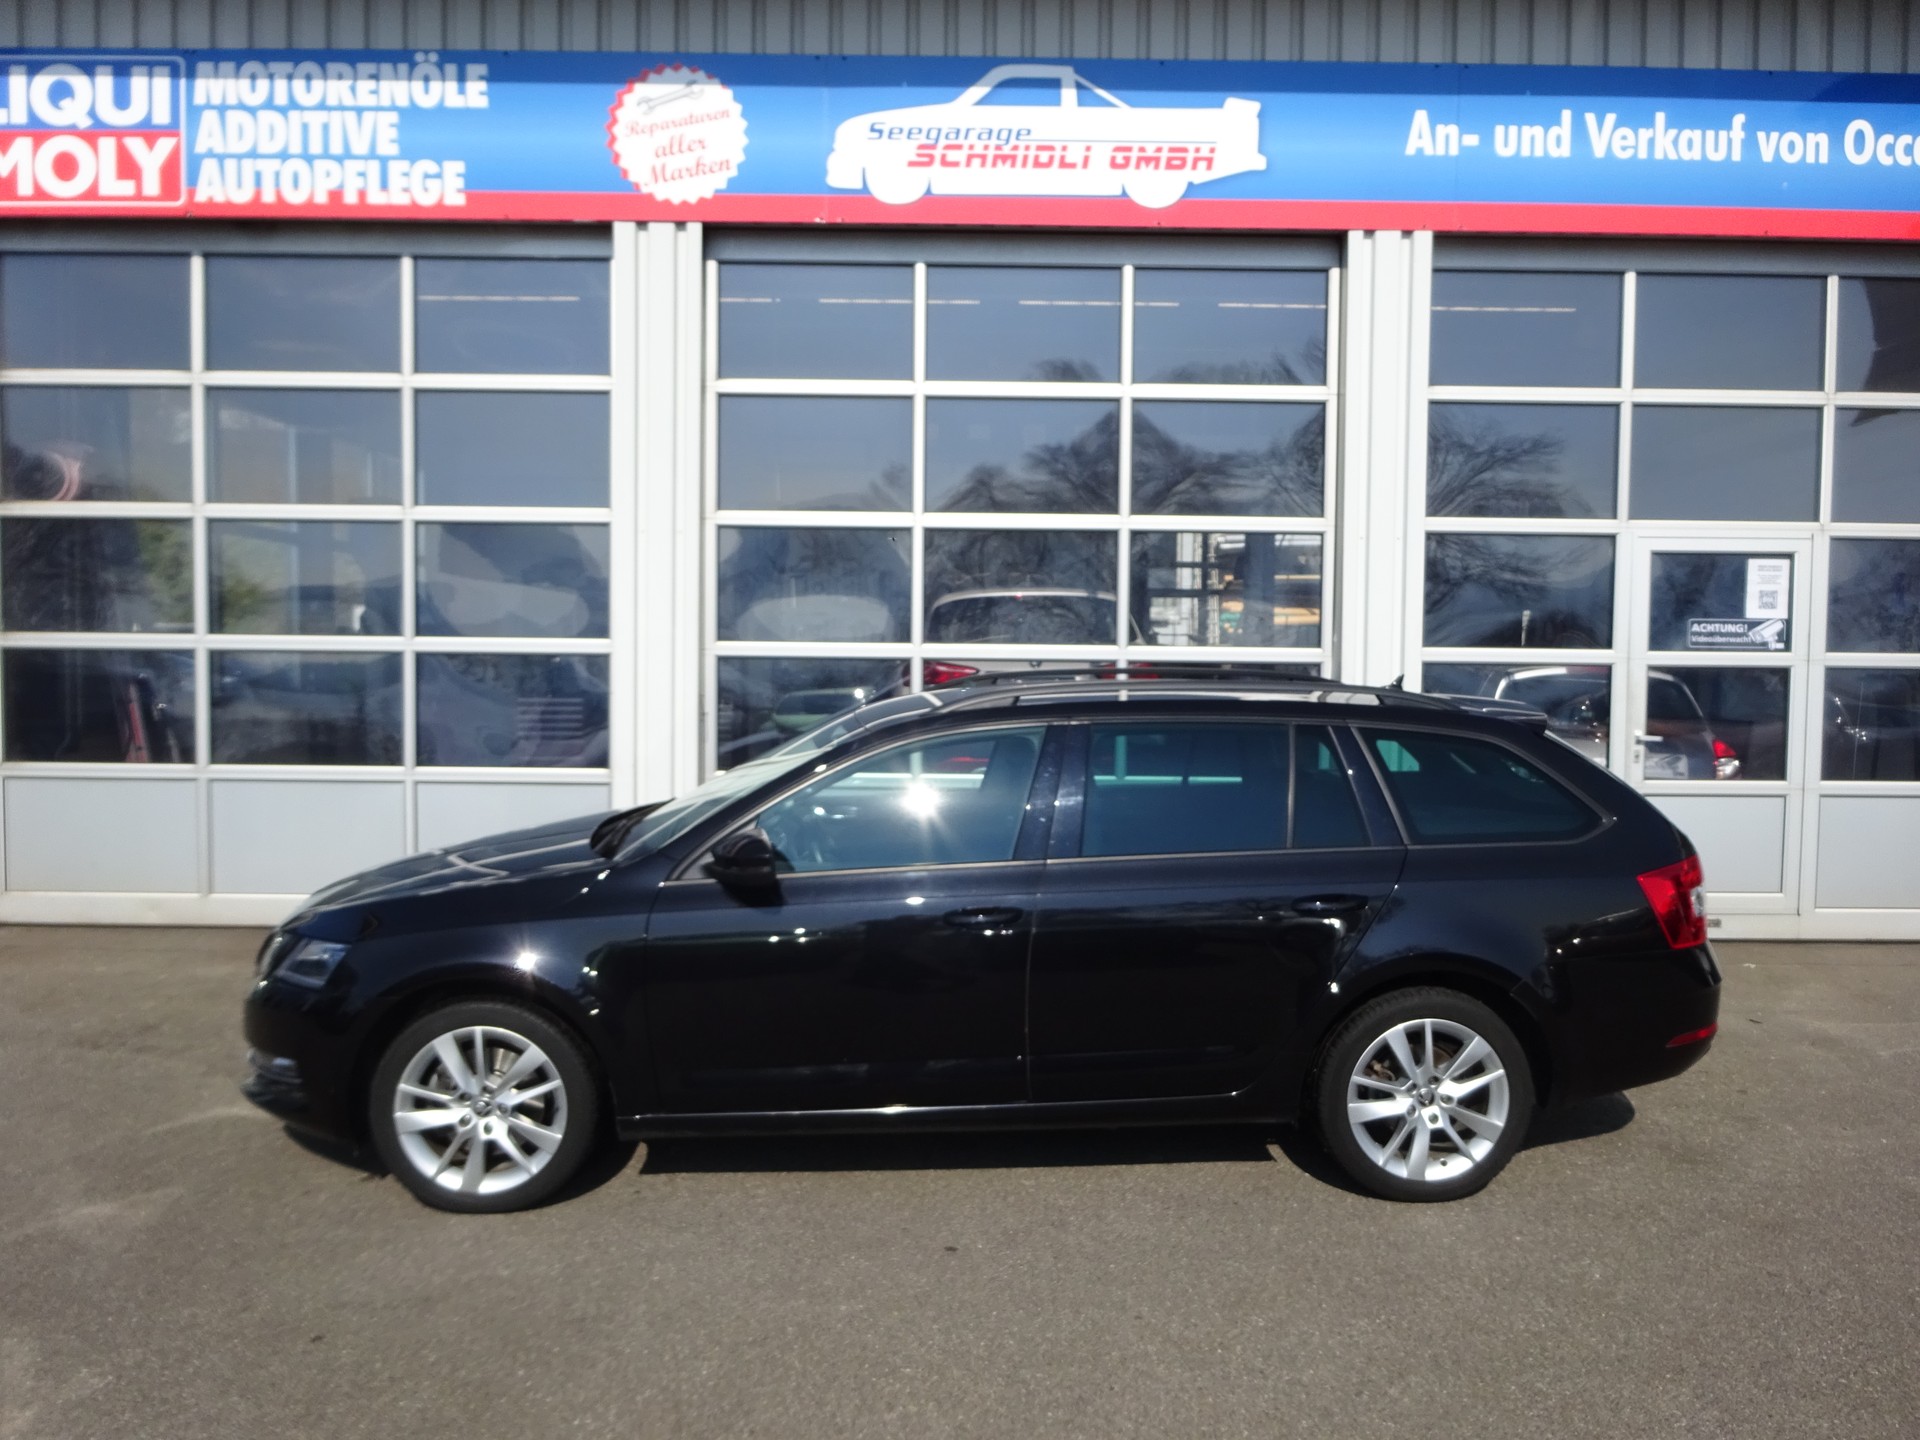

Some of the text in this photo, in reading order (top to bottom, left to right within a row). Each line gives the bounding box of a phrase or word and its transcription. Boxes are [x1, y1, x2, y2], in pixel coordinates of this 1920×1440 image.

[194, 51, 489, 108] MOTORENÖLE
[0, 63, 171, 129] IQUI
[194, 110, 399, 156] ADDITIVE
[624, 108, 730, 137] Reparaturen
[867, 122, 1032, 146] Seegarage
[655, 133, 706, 159] aller
[1405, 109, 1920, 167] An- und Verkauf von Occ
[643, 156, 732, 186] Marken
[907, 144, 1218, 171] SCHMIDLI GMBH
[194, 159, 467, 206] AUTOPFLEGE
[1691, 623, 1749, 633] ACHTUNG!
